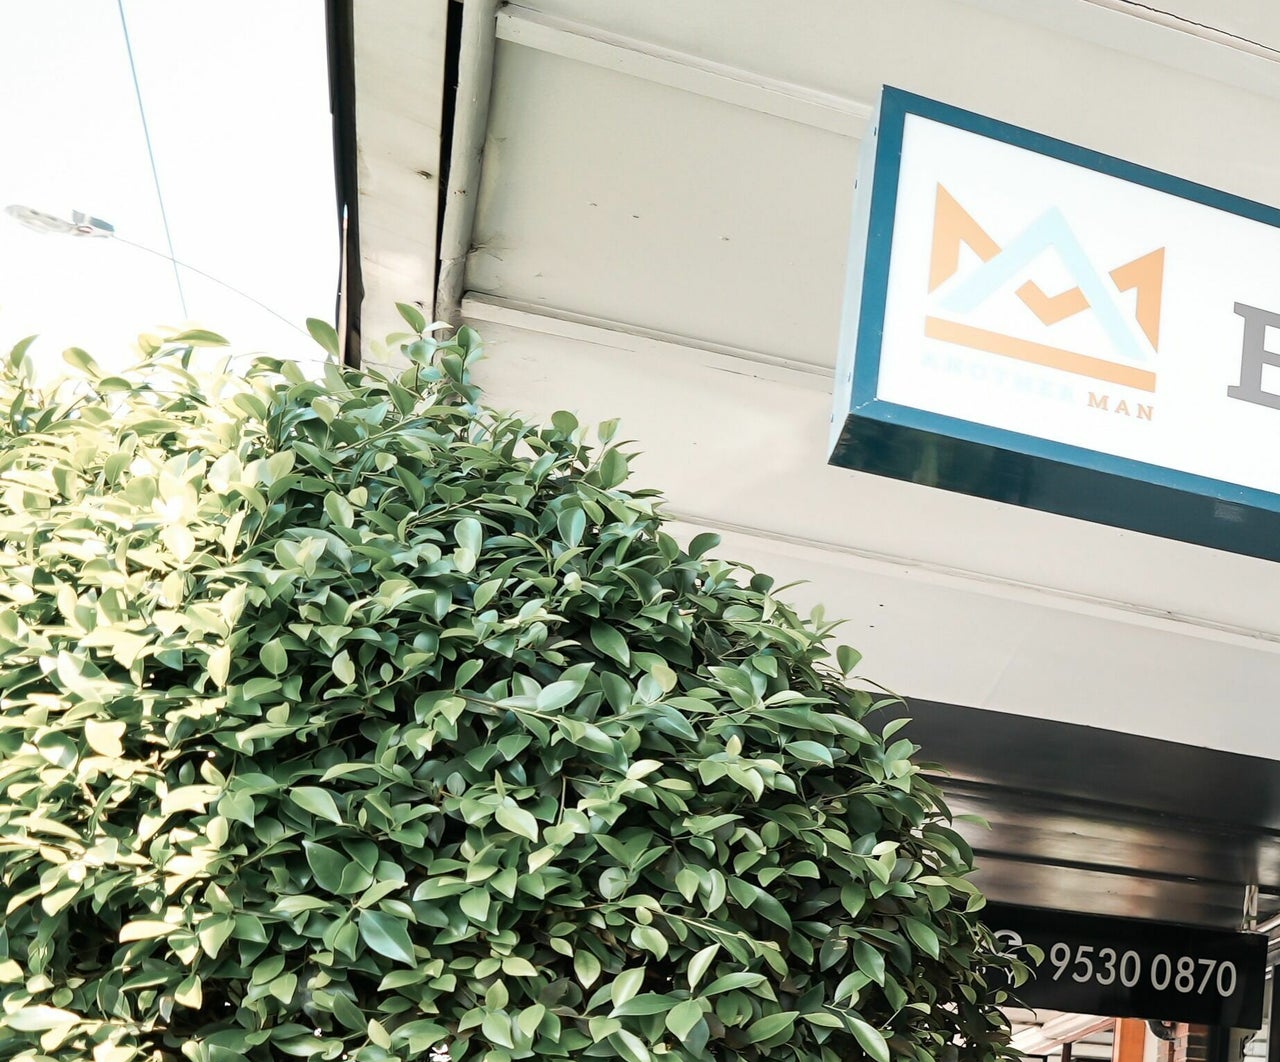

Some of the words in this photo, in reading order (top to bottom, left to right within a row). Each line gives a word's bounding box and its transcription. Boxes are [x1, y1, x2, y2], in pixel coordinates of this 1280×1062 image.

[1088, 392, 1154, 421] MAN
[1050, 942, 1141, 988] 9530
[1151, 953, 1237, 997] 0870
